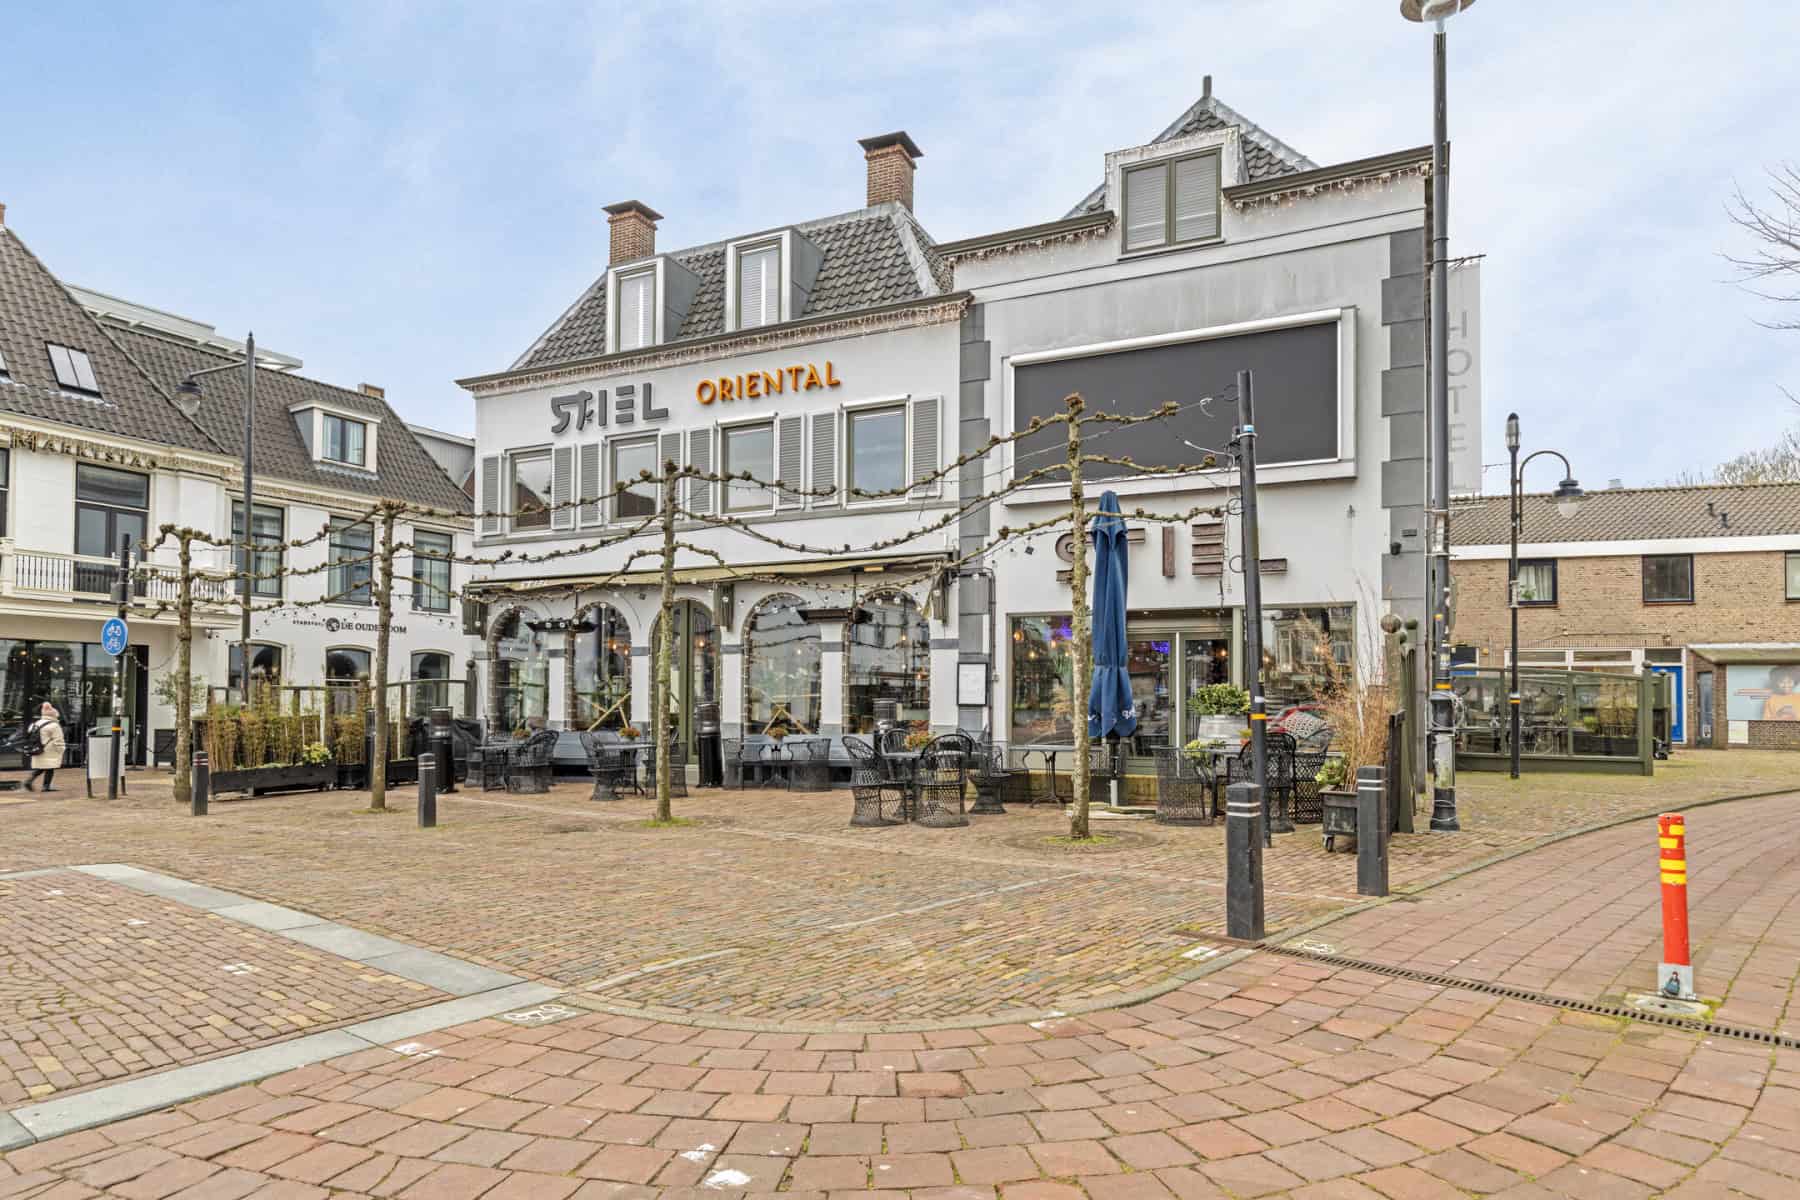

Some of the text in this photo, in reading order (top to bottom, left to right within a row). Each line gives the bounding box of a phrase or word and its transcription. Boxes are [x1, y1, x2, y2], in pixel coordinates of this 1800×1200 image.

[551, 382, 669, 434] STIEL
[696, 361, 841, 405] ORIENTAL
[1448, 312, 1473, 490] HOTEL
